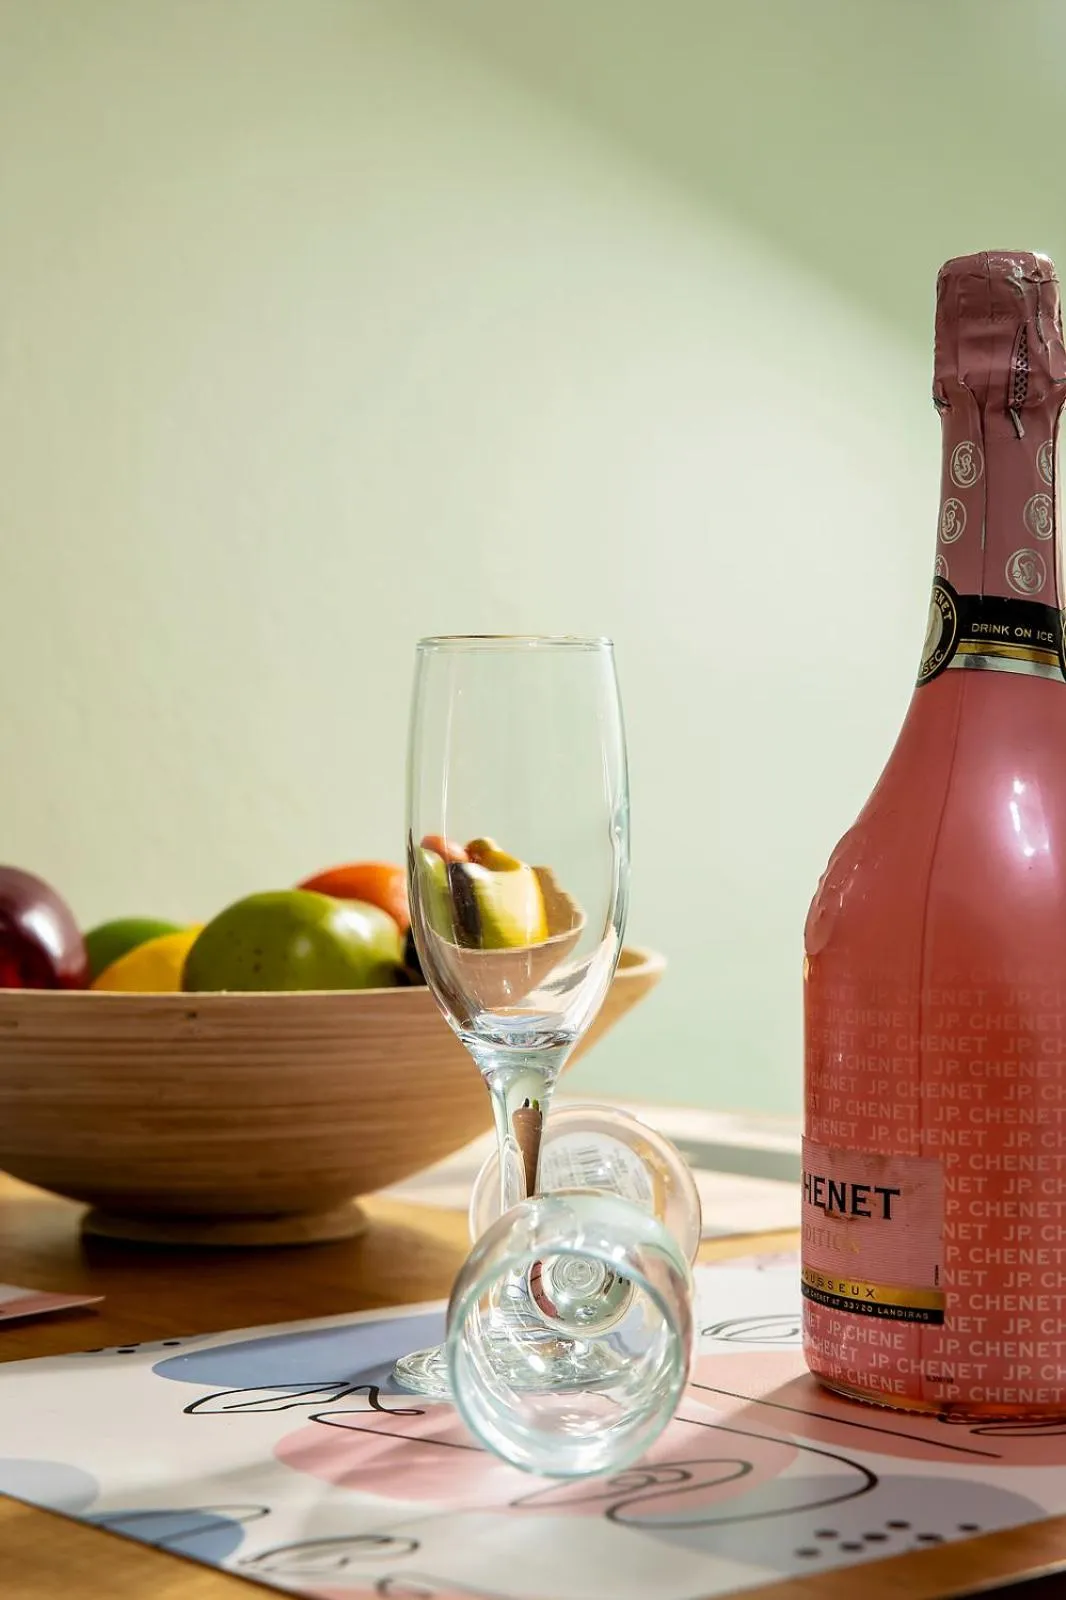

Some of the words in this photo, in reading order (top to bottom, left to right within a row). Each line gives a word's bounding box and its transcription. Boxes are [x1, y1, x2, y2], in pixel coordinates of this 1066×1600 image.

[972, 623, 1009, 635] DRINK
[1015, 627, 1032, 637] ON
[1037, 632, 1054, 643] ICE
[922, 650, 943, 674] SEC
[969, 1013, 1066, 1032] CHENET
[896, 1034, 987, 1054] CHENET
[846, 1055, 918, 1075] CHENET
[969, 1060, 1066, 1078] CHENET
[896, 1081, 987, 1100] CHENET
[846, 1100, 918, 1121] CHENET
[969, 1107, 1066, 1125] CHENET
[896, 1127, 987, 1147] CHENET
[969, 1154, 1066, 1171] CHENET
[803, 1172, 900, 1220] HENET
[969, 1201, 1066, 1218] CHENET
[942, 1222, 987, 1241] NET
[969, 1247, 1066, 1264] CHENET
[877, 1304, 929, 1320] LANDIRAS
[969, 1294, 1066, 1311] CHENET
[969, 1341, 1066, 1357] CHENET
[896, 1357, 987, 1380] CHENET
[969, 1386, 1064, 1403] CHENET
